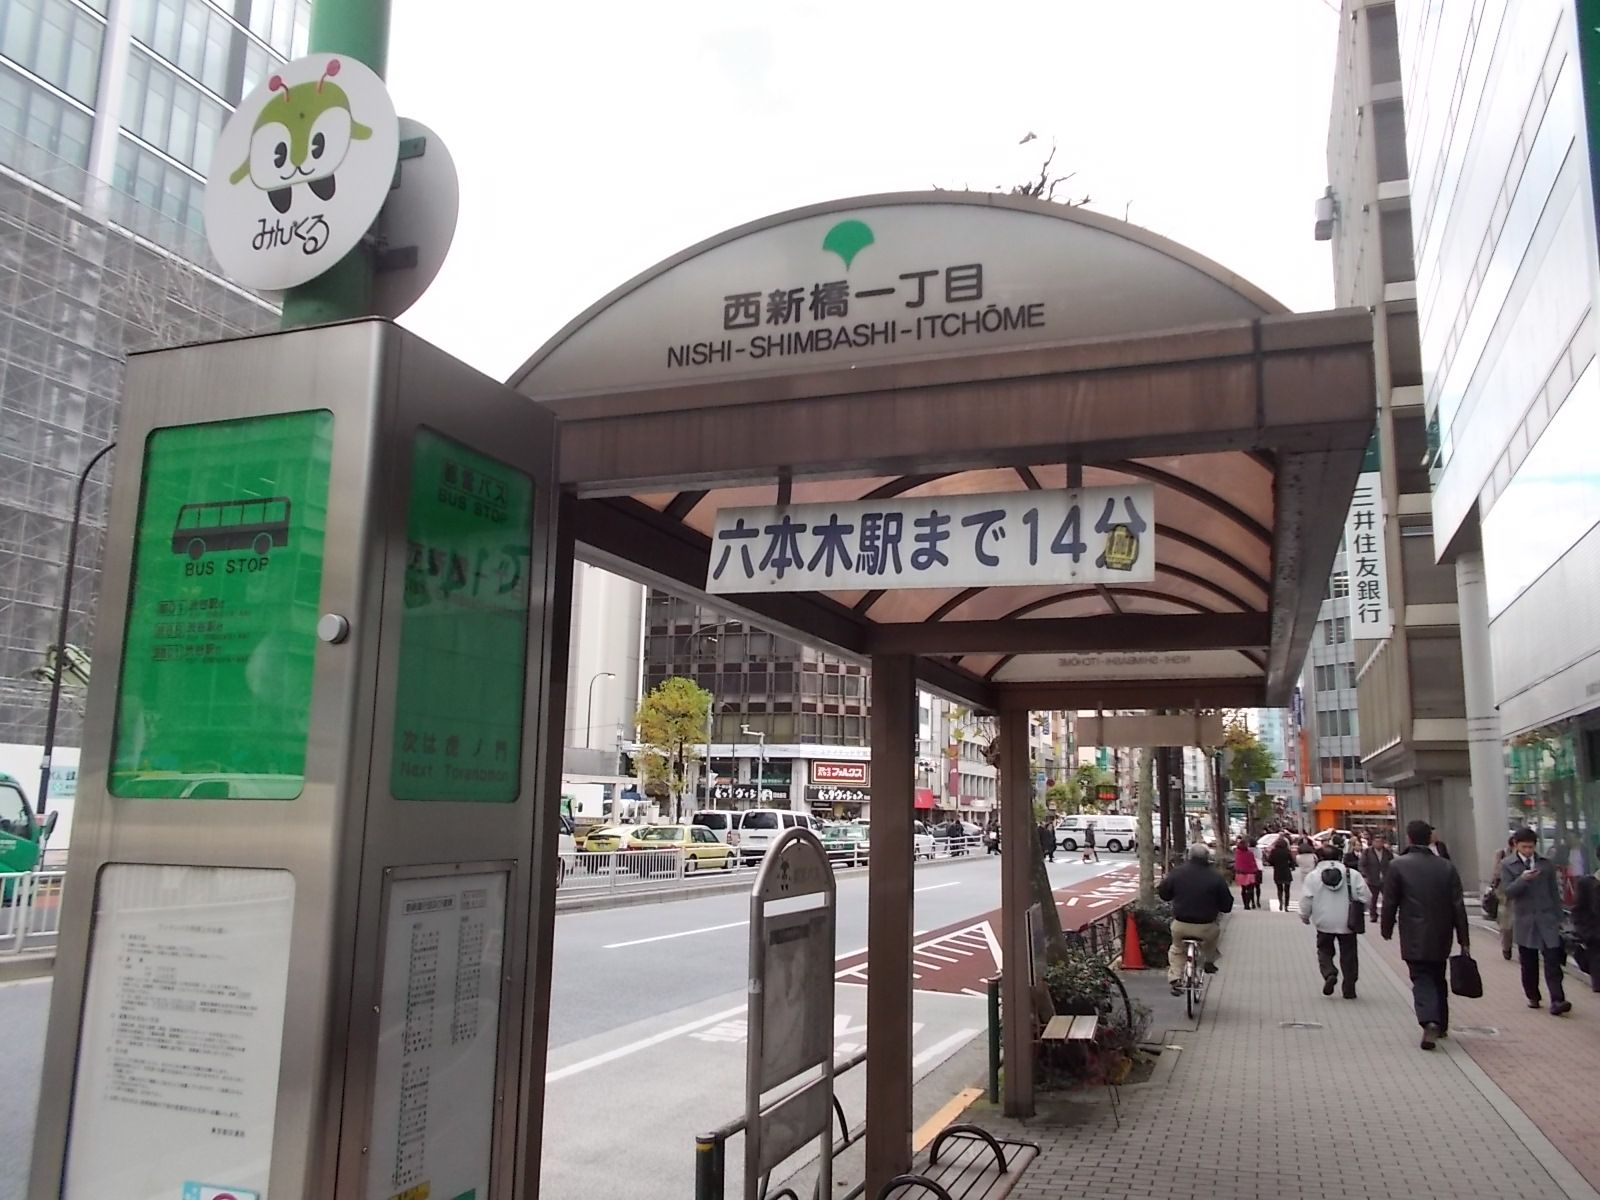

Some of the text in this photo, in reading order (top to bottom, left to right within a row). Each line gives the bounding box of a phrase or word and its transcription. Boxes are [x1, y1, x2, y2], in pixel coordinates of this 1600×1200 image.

[252, 214, 330, 255] みんくる
[723, 263, 983, 331] 西新橋一丁目
[185, 557, 269, 577] BUS STOP
[1352, 487, 1382, 624] 三井住友銀行
